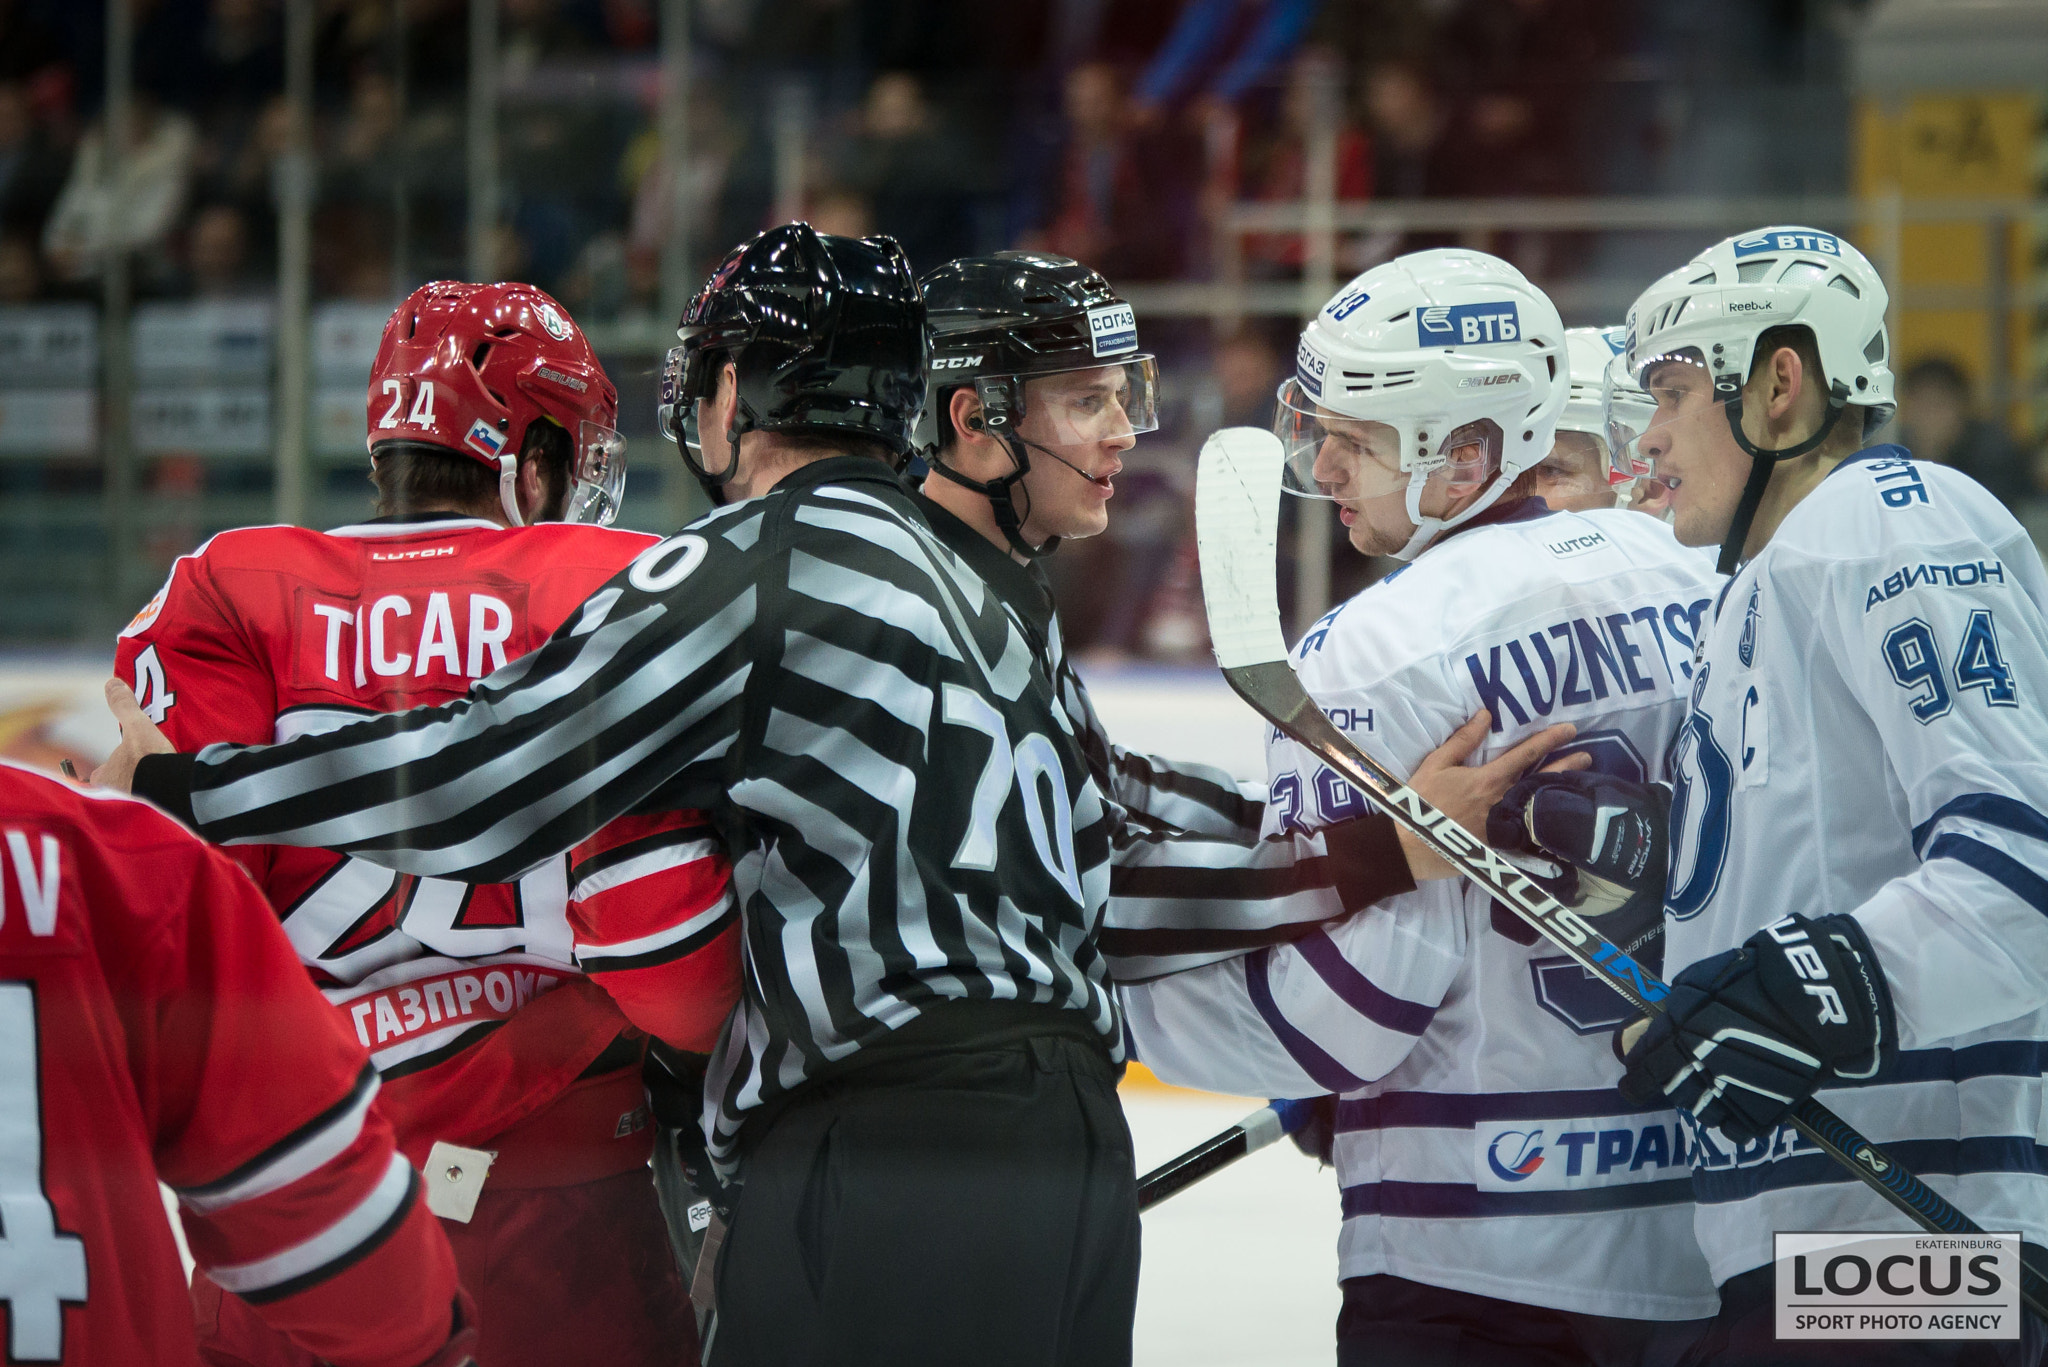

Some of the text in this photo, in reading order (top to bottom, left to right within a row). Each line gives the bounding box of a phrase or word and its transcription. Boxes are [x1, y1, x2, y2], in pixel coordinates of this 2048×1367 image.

[1777, 234, 1837, 254] ВТБ
[1091, 312, 1134, 331] СОГАЗ
[1460, 313, 1517, 343] ВТБ
[537, 367, 589, 394] BAUER
[931, 355, 984, 370] CCM
[1457, 373, 1522, 388] BAUER
[378, 379, 437, 431] 24
[372, 547, 454, 561] LUTCH
[1549, 532, 1606, 555] LUTCH
[1865, 561, 2005, 614] АВИЛОН
[313, 591, 513, 689] TICAR
[1881, 609, 2020, 727] 94
[941, 682, 1085, 909] 70
[0, 830, 61, 936] V
[1385, 785, 1598, 948] NEXUS
[350, 969, 559, 1048] ГАЗПРОМ
[1860, 965, 1879, 1013] VAPOR
